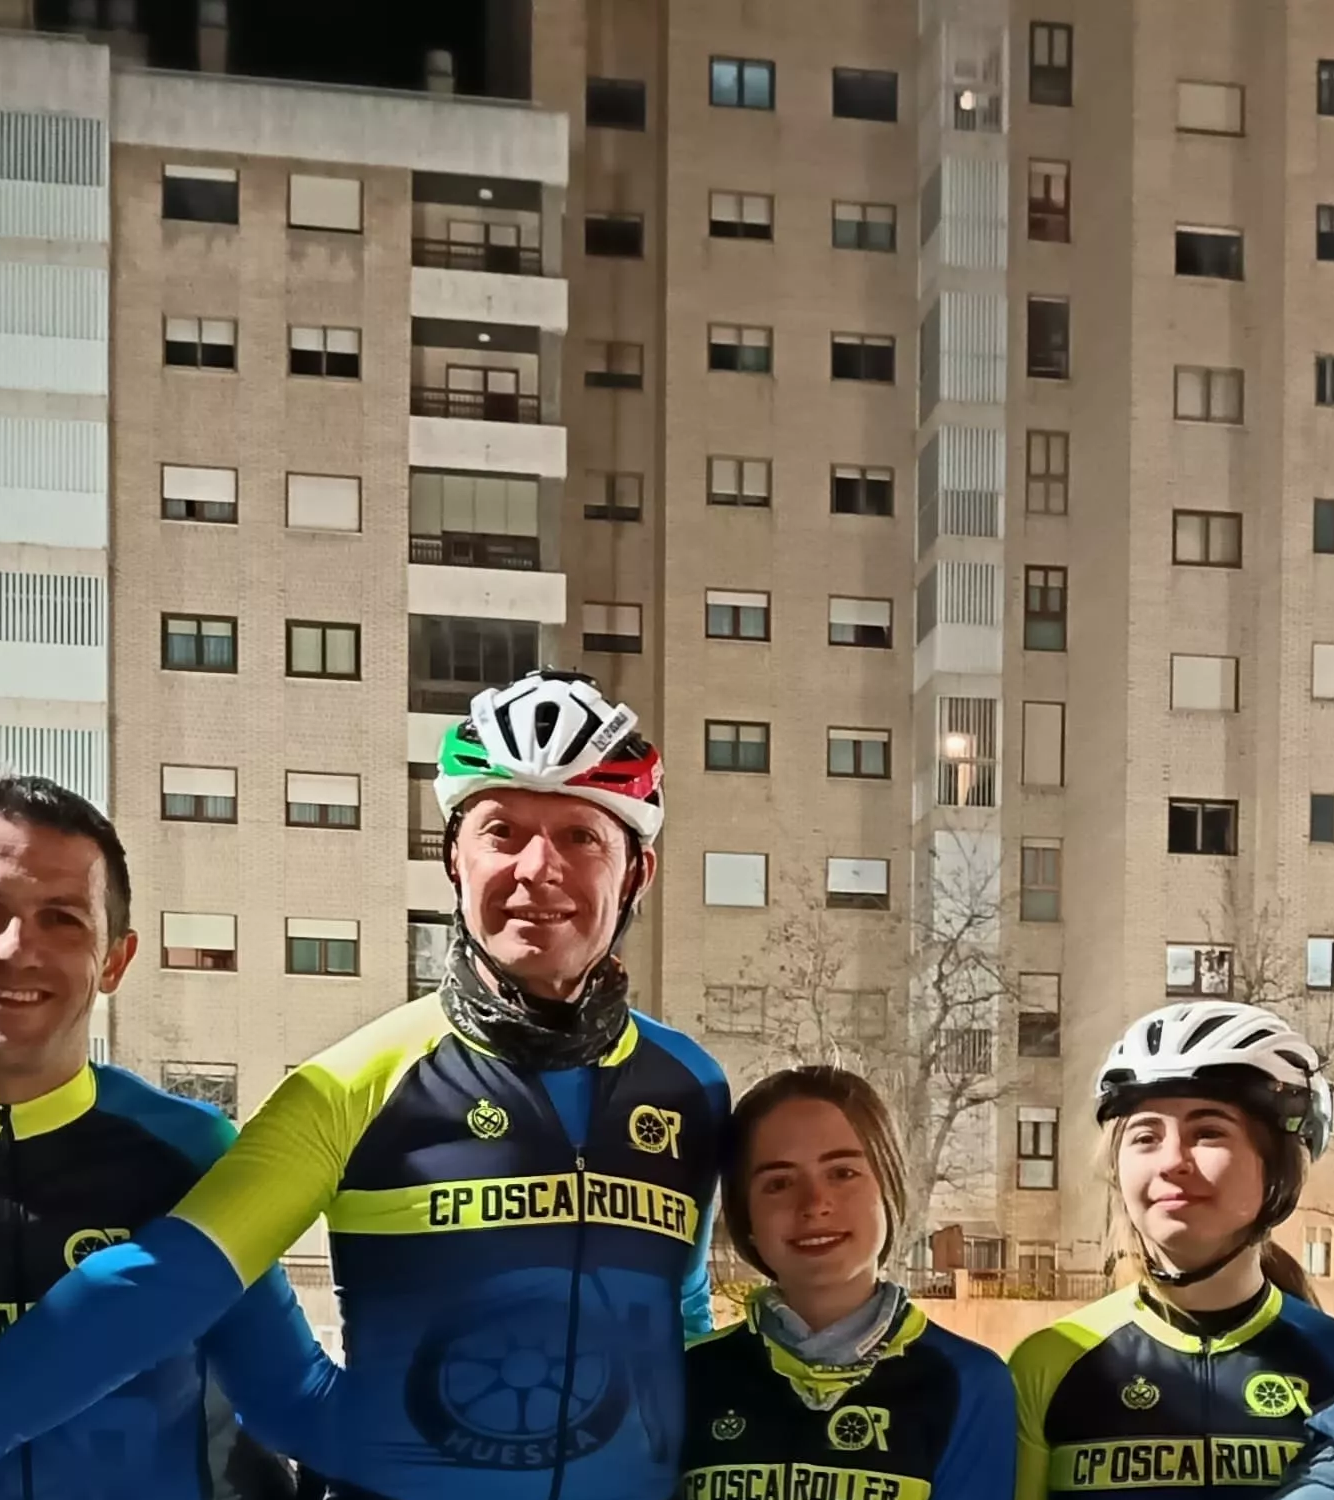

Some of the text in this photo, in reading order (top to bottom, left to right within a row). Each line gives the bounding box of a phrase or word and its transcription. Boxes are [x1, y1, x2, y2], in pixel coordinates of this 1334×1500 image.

[430, 1179, 686, 1236] CP OSCA ROLLER
[1074, 1449, 1106, 1485] CP
[1110, 1445, 1200, 1482] OSCA
